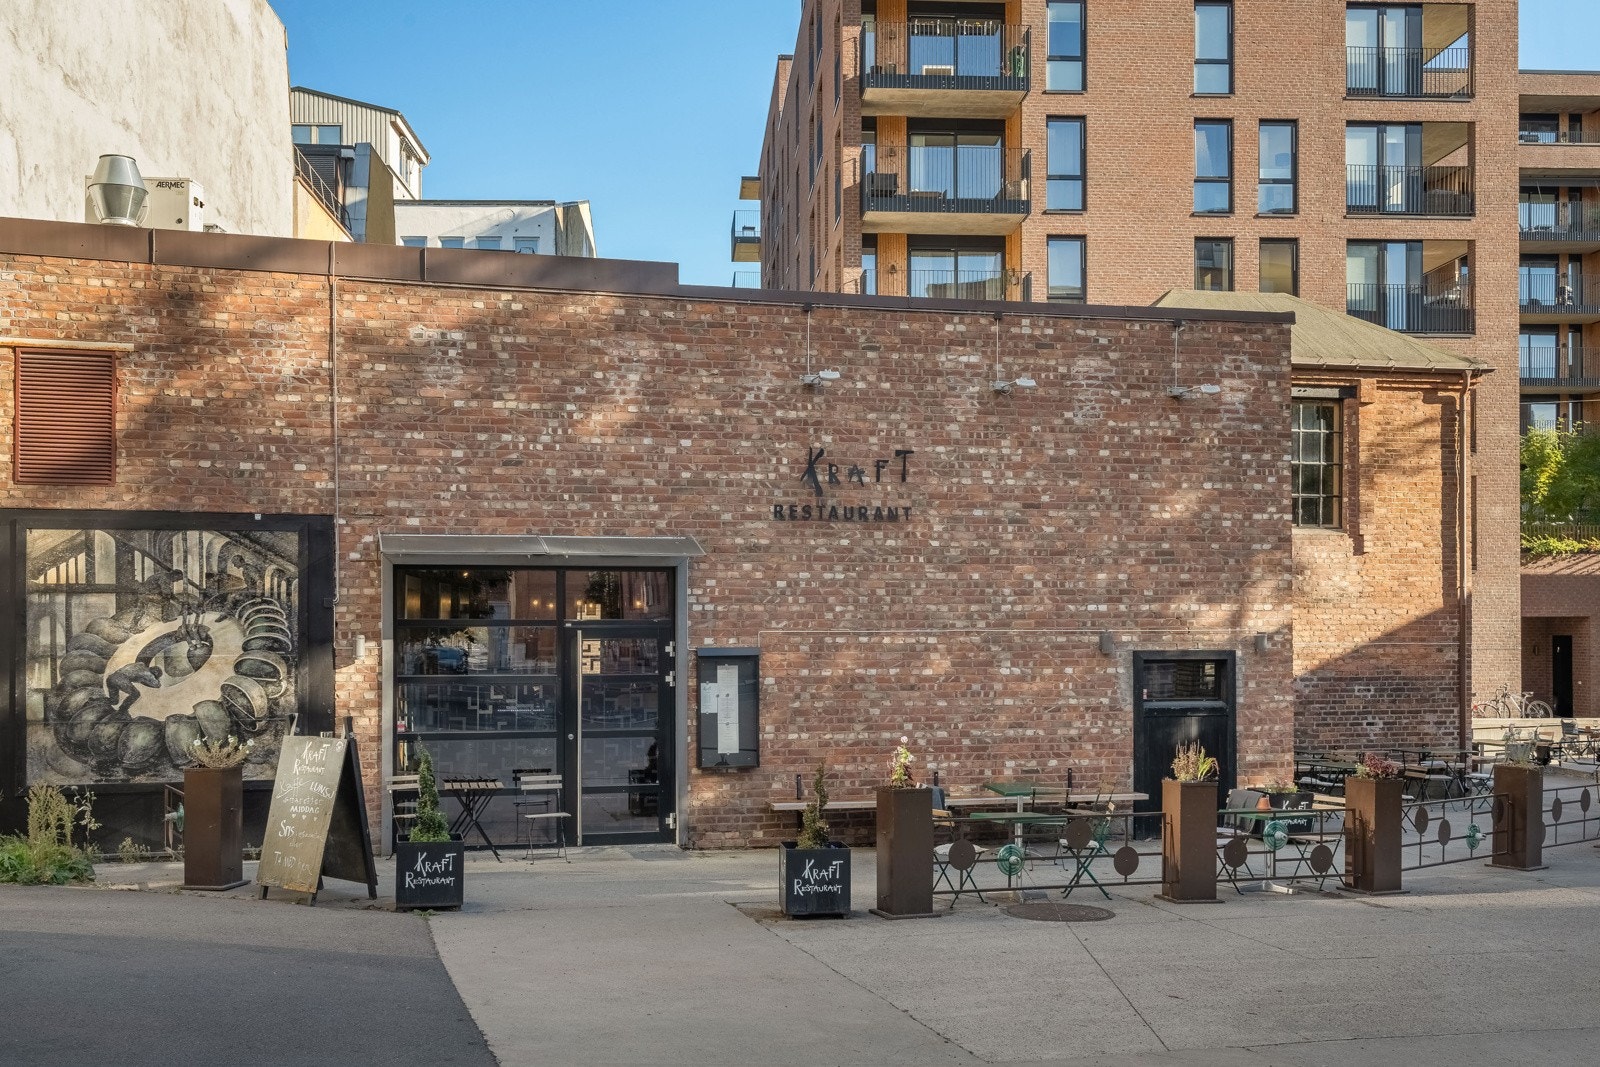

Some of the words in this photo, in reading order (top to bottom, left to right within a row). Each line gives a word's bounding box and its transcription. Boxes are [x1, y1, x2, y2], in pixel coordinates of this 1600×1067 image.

[156, 181, 185, 190] AERMEC
[800, 446, 914, 497] KRAFT
[773, 504, 912, 521] RESTAURANT
[290, 805, 320, 814] MIDDAG
[413, 851, 457, 877] KRAFT
[802, 859, 844, 885] KRAFT
